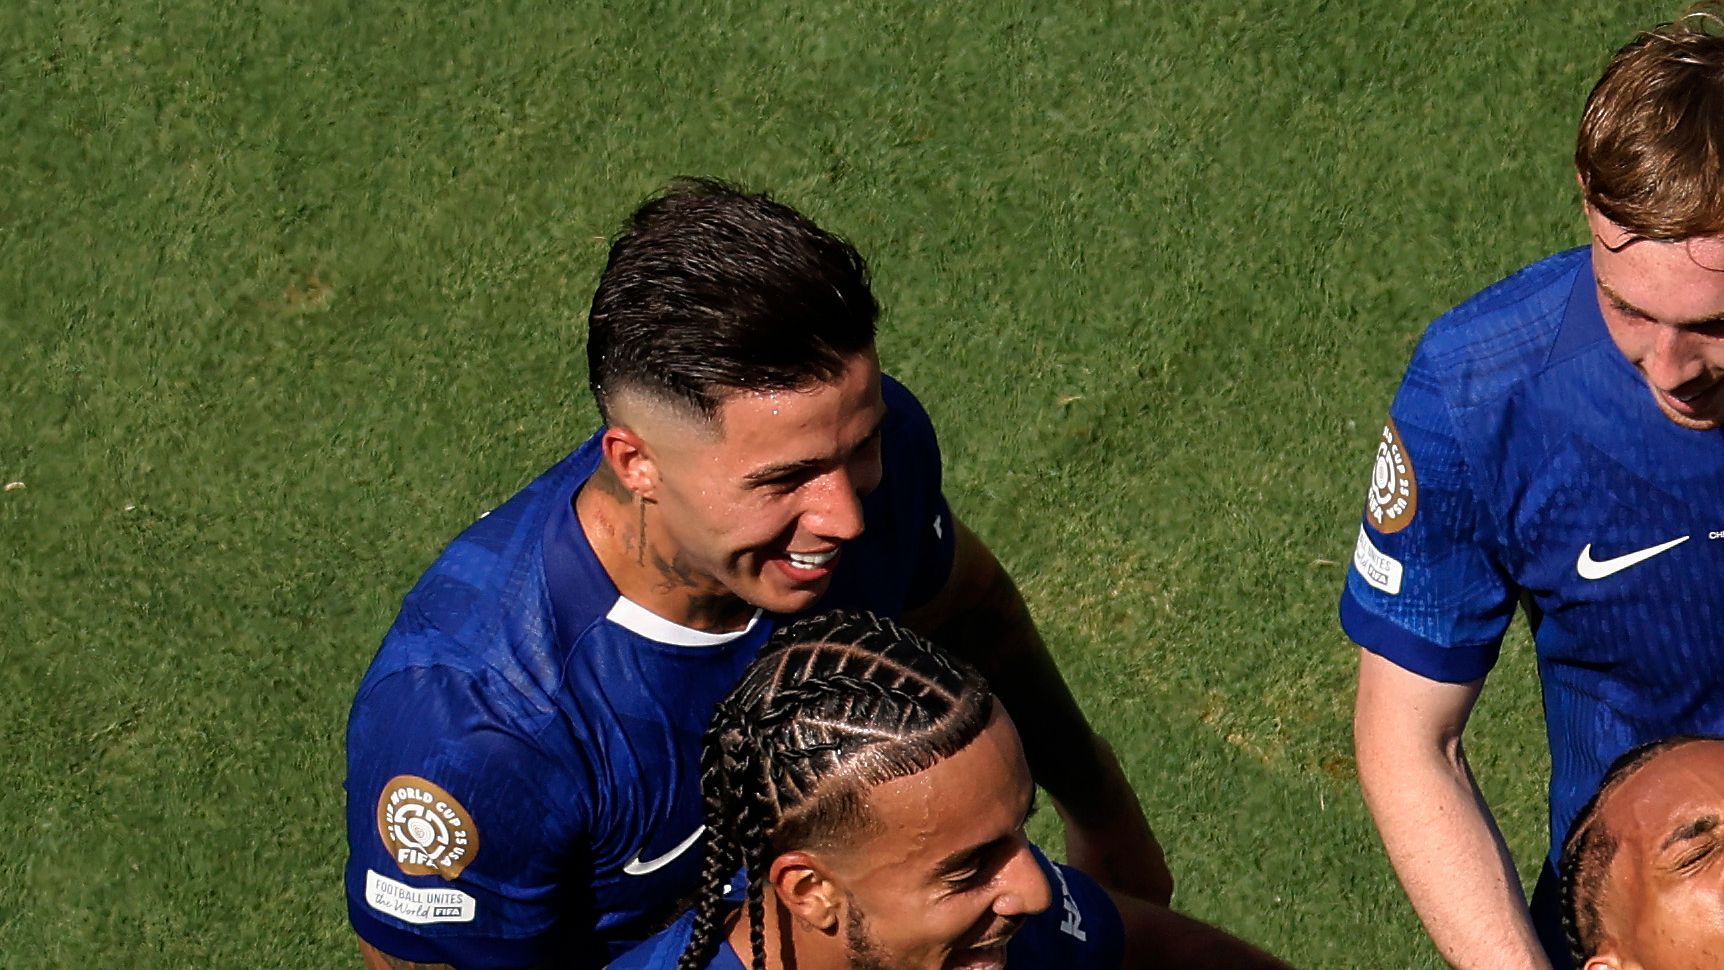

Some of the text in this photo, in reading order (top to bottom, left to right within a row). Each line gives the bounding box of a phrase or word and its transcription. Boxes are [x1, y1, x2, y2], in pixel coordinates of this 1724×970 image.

[1386, 444, 1409, 519] CUP 25 USA
[390, 787, 433, 805] WORLD
[435, 801, 462, 828] CUP
[454, 830, 468, 845] 25
[397, 848, 439, 870] FIFA
[440, 847, 465, 867] USA
[376, 879, 463, 904] FOOTBALL UNITES
[375, 893, 431, 918] the World
[434, 906, 462, 917] FIFA
